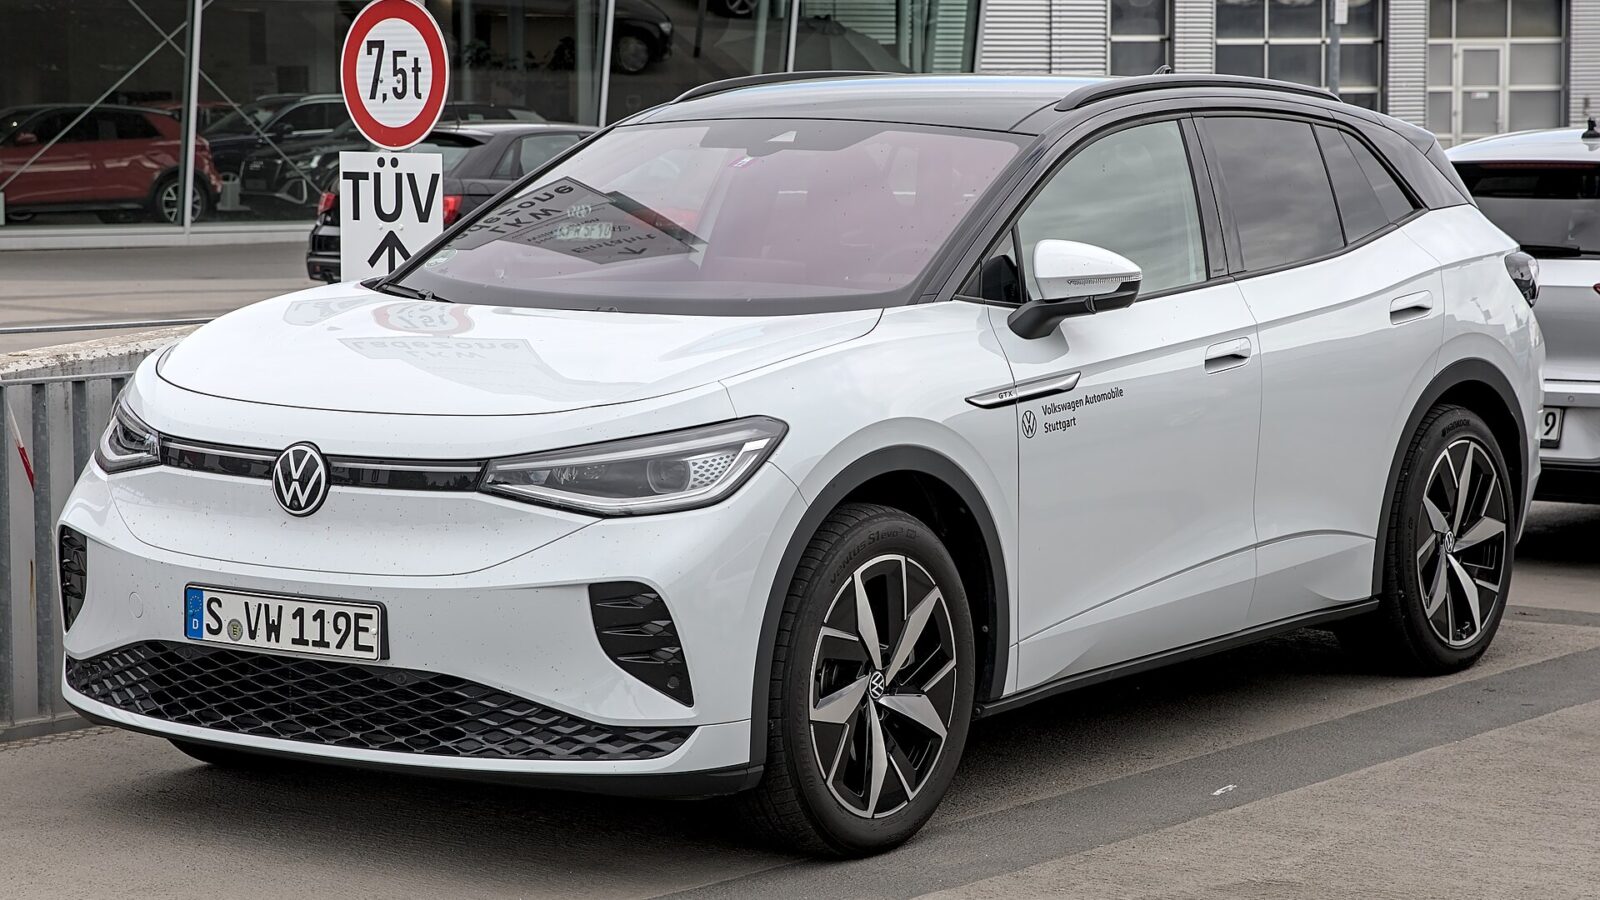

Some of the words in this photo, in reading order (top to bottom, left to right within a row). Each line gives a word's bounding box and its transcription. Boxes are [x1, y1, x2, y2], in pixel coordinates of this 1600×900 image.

[366, 40, 422, 103] 7,5t
[342, 156, 441, 223] TÜV
[998, 390, 1013, 399] GTX
[1041, 397, 1084, 416] Volkswagen
[1084, 387, 1124, 407] Automobile
[1044, 416, 1077, 434] Stuttgart
[192, 618, 199, 630] D
[205, 596, 223, 636] S
[244, 601, 283, 643] VW
[291, 607, 374, 653] 119E
